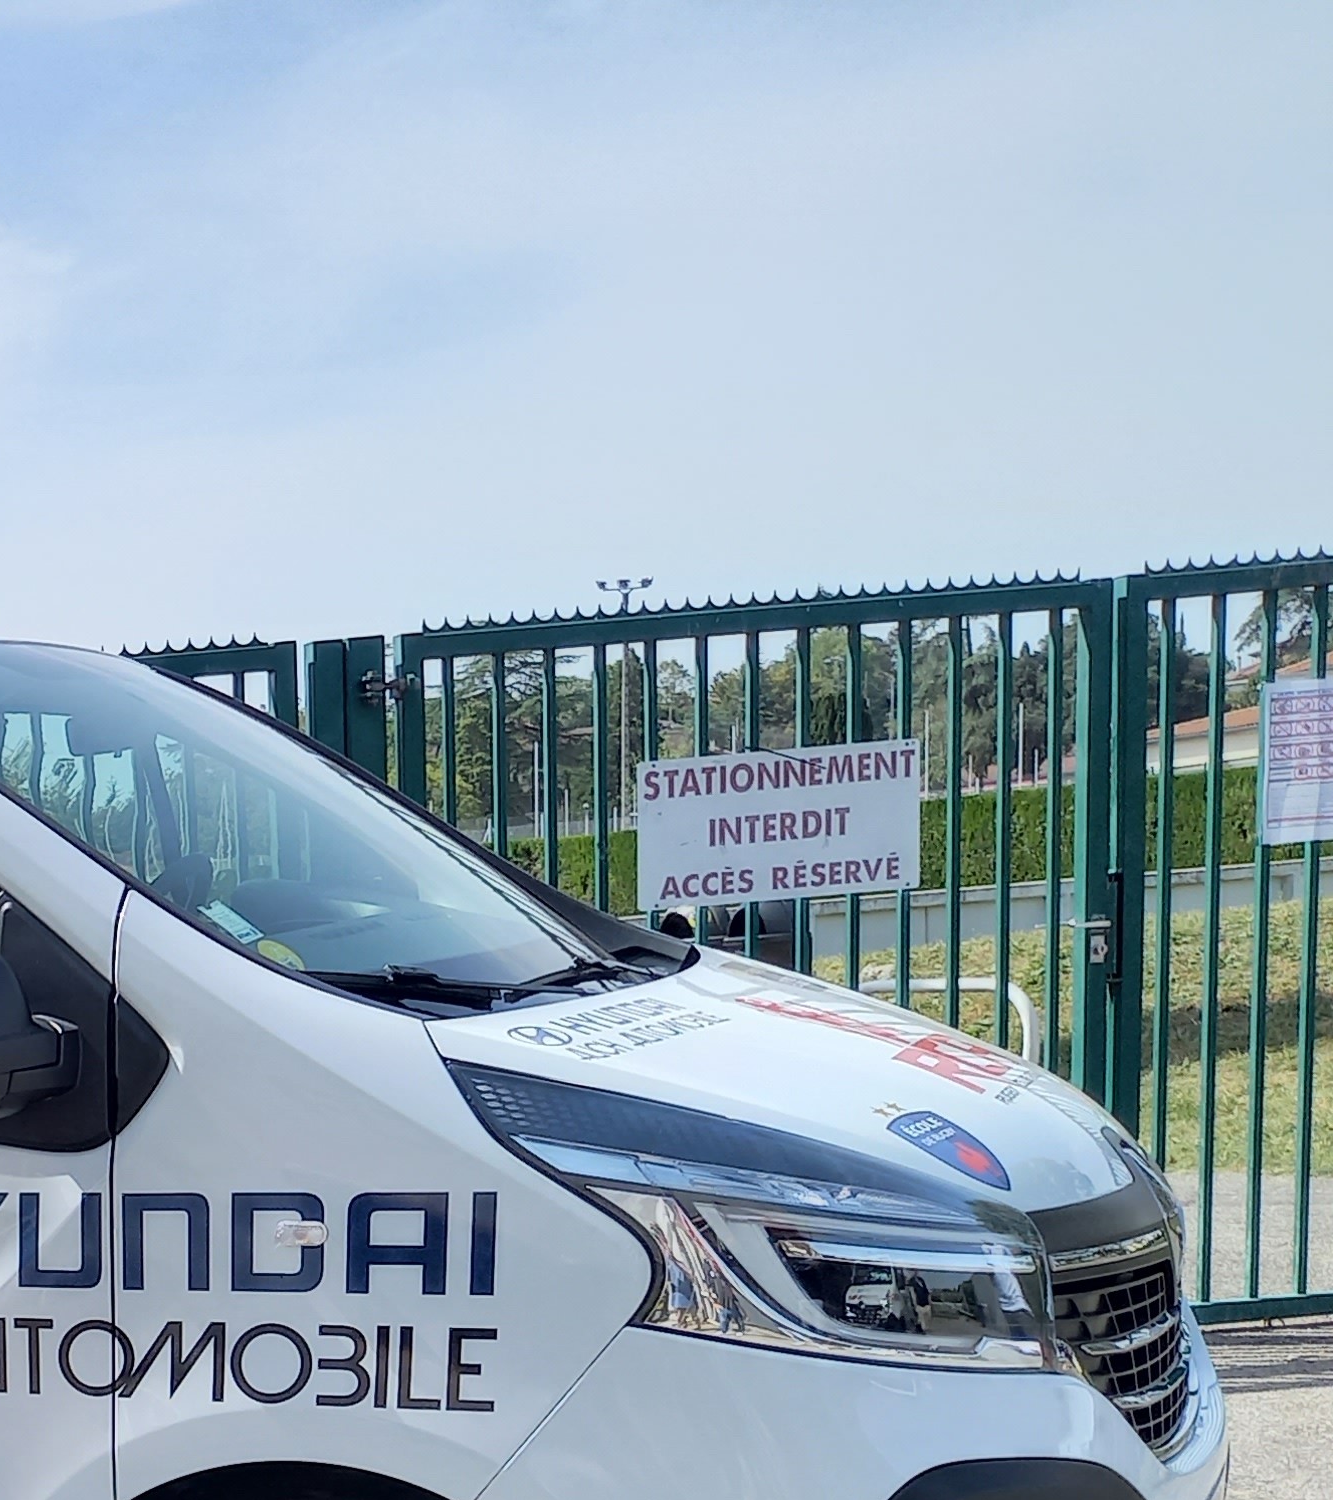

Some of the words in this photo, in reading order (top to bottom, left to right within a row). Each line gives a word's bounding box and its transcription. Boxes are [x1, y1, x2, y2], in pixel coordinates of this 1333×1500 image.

[643, 749, 917, 802] STATIONNEMENT
[708, 806, 851, 848] INTERDIT
[658, 866, 755, 901] ACCÈS
[771, 852, 901, 891] RÉSERVÉ
